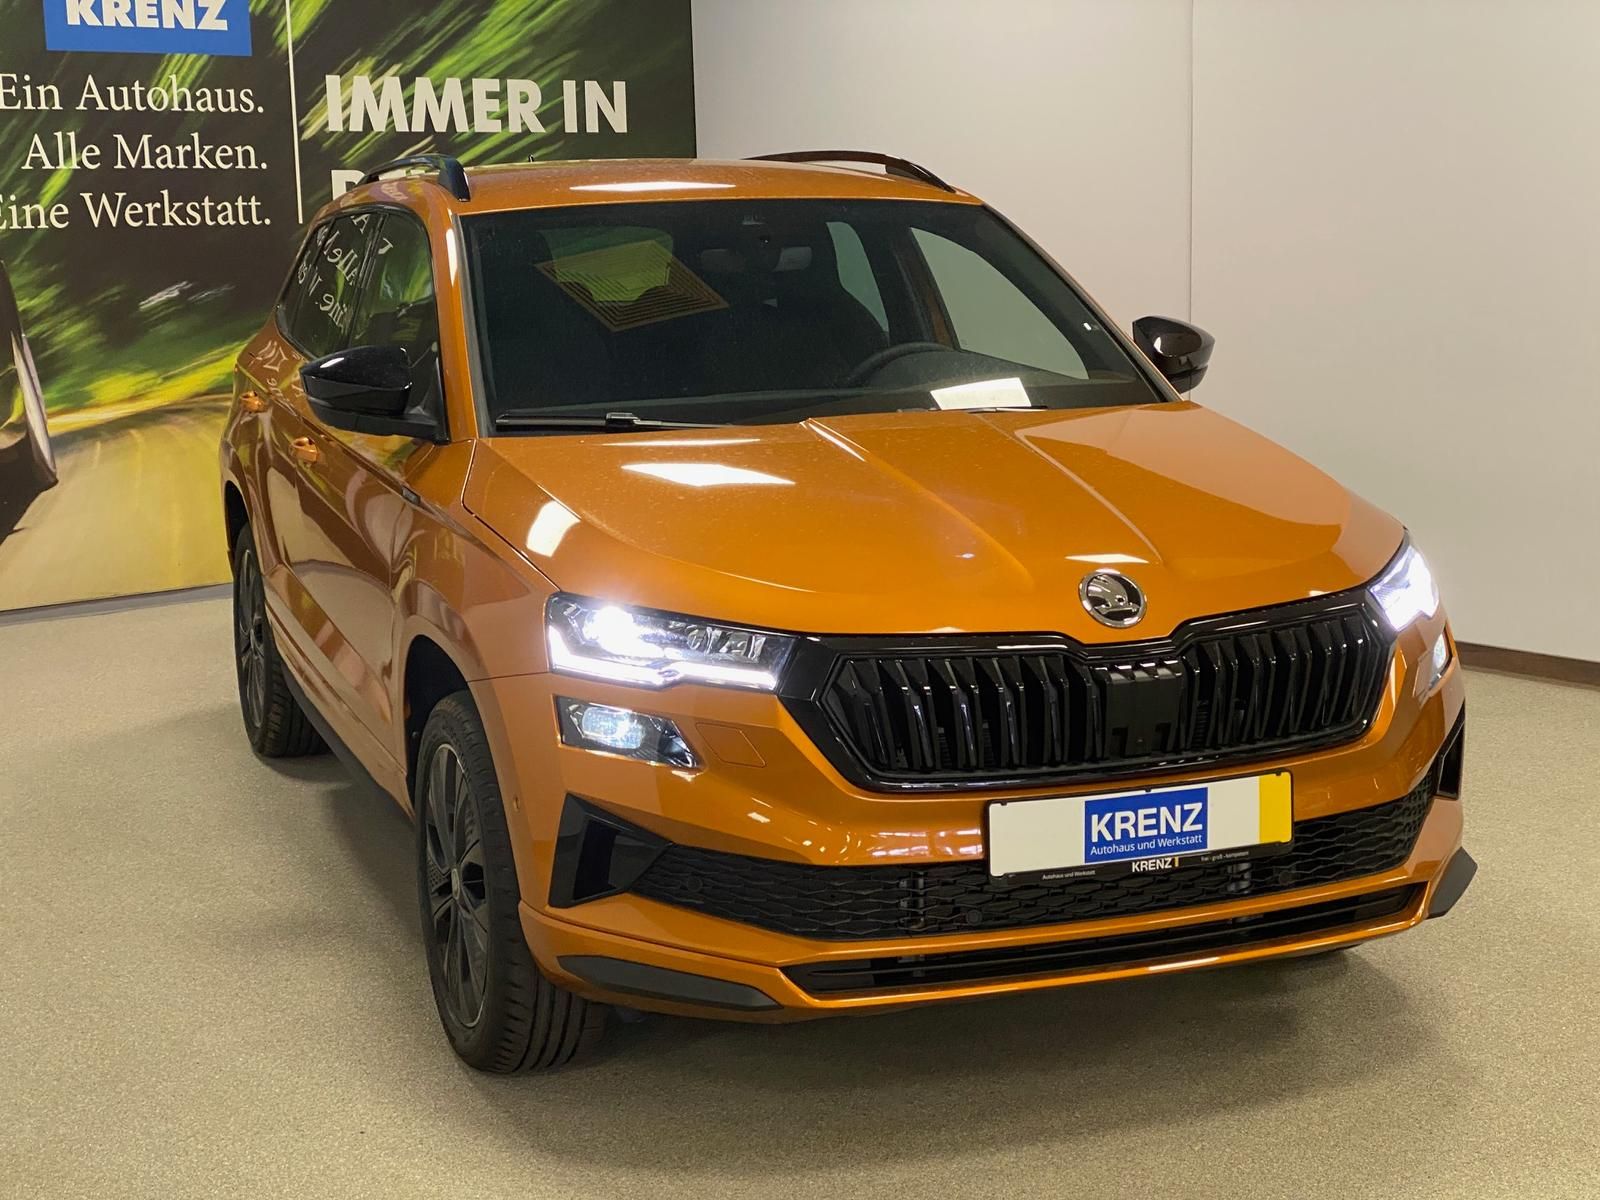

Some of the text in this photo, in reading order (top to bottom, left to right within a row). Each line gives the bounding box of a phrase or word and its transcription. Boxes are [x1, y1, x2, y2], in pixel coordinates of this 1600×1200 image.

[65, 0, 229, 31] KRENZ
[0, 73, 265, 113] Ein Autohaus.
[325, 74, 628, 134] IMMER IN
[21, 130, 268, 170] Alle Marken.
[80, 188, 272, 229] Werkstatt.
[1091, 802, 1203, 843] KRENZ
[1090, 834, 1203, 856] Autohaus und Werkstatt
